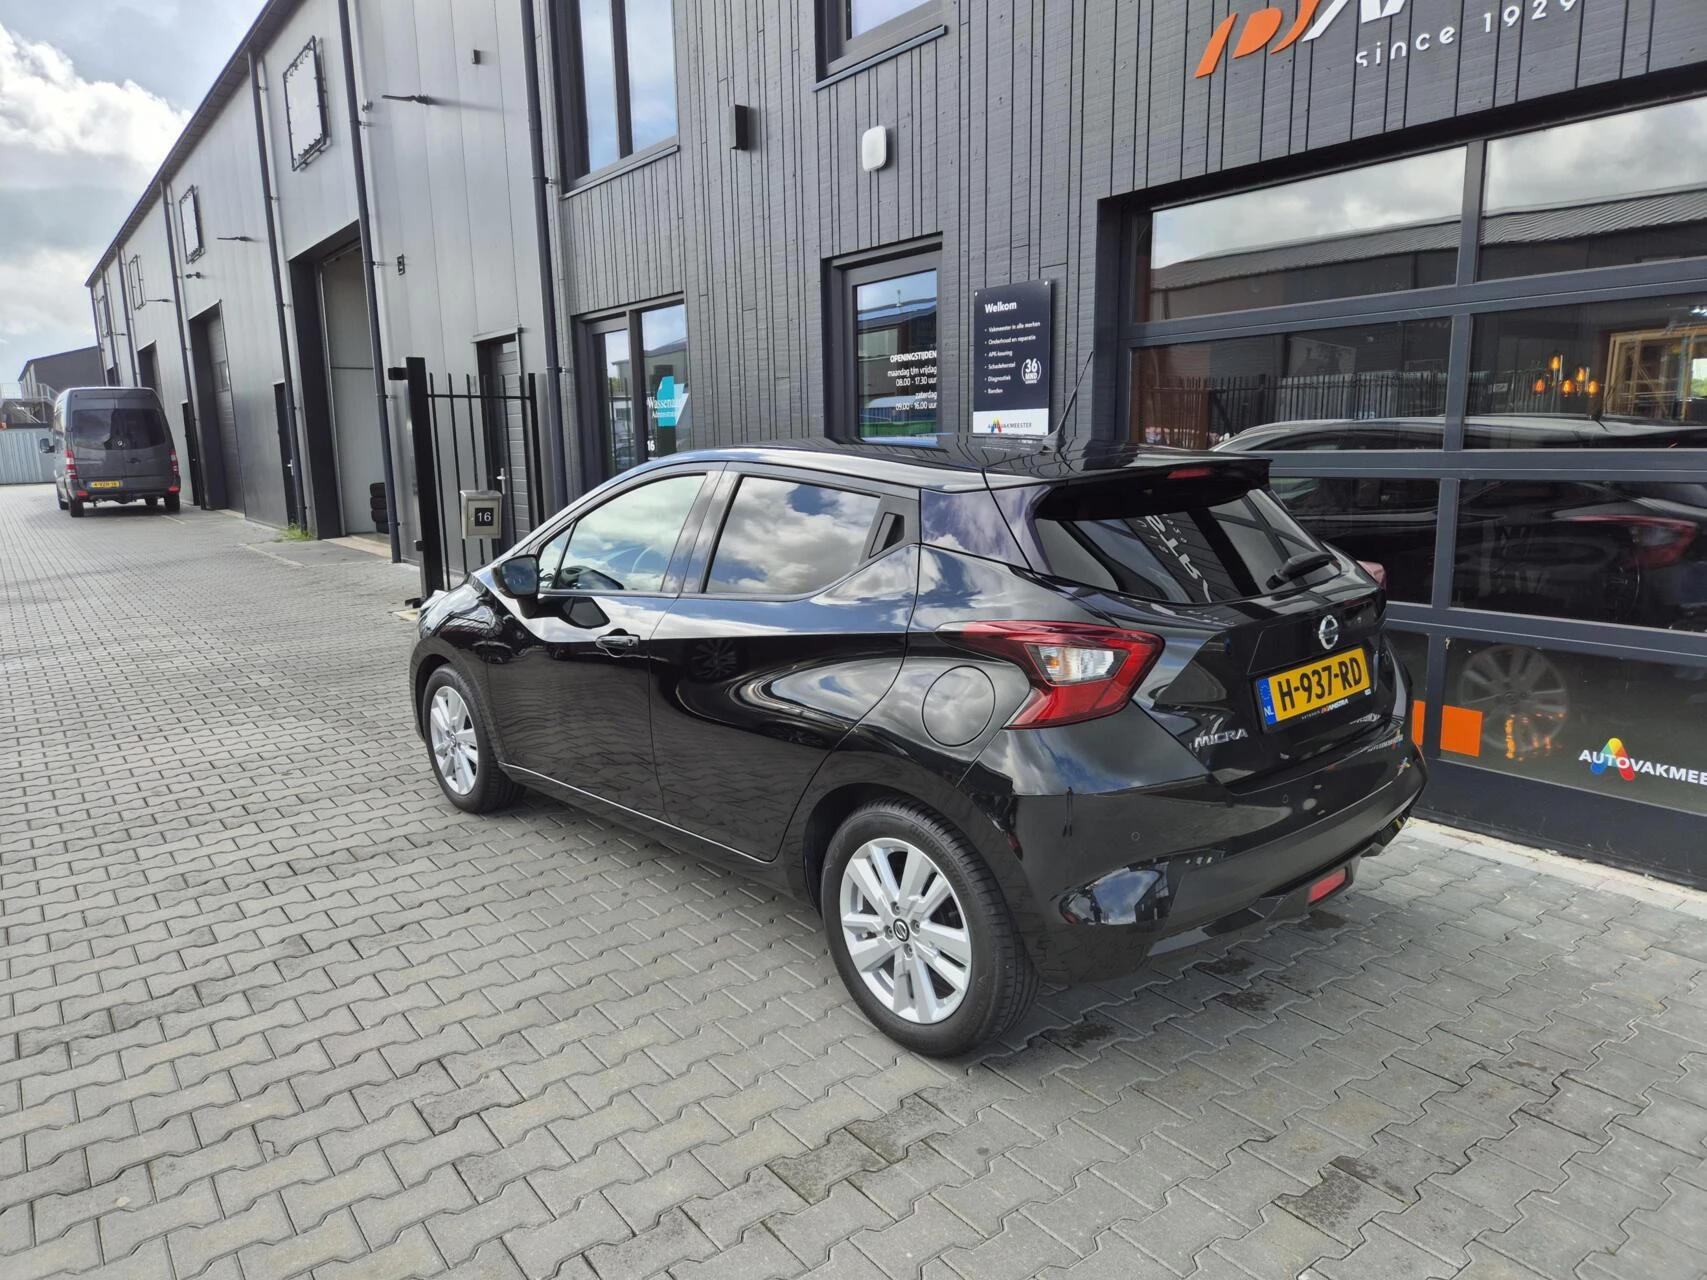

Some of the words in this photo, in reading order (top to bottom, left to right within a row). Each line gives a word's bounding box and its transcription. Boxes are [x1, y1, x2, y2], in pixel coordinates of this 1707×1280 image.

[1355, 25, 1456, 67] since
[985, 301, 1017, 314] Welkom
[988, 337, 1011, 345] Onderhoud
[1018, 334, 1036, 343] reparatie
[889, 350, 937, 363] OPENINGSTIJDEN
[1025, 358, 1038, 372] 36
[887, 368, 910, 377] maandag
[910, 366, 919, 375] t/m
[920, 365, 937, 375] vrijdag
[896, 379, 910, 387] 08.00
[915, 377, 927, 385] 17.30
[915, 391, 937, 400] zaterdag
[928, 401, 937, 409] uur
[646, 440, 656, 451] 16
[478, 511, 492, 522] 16
[1277, 657, 1363, 712] H-937-RD
[1264, 706, 1275, 716] NL
[1194, 728, 1249, 748] MICRA
